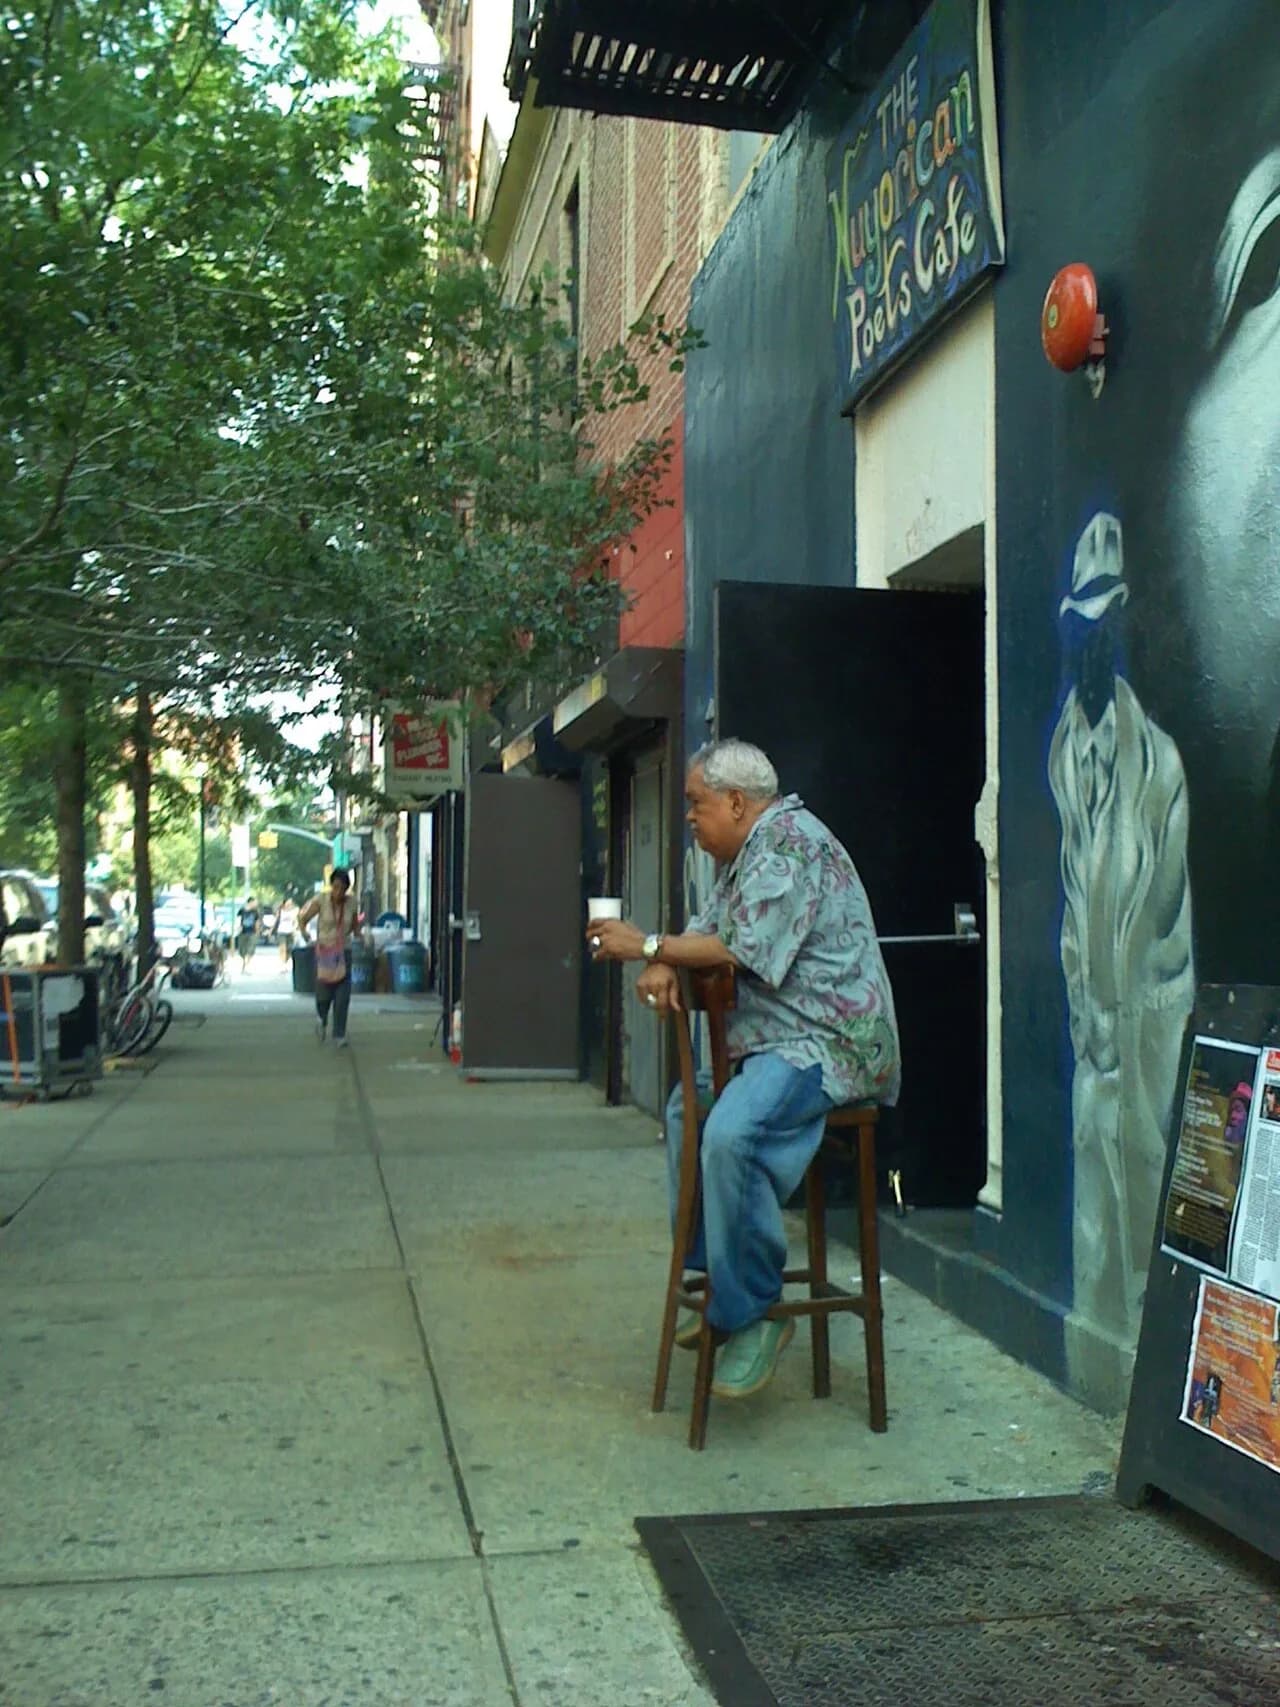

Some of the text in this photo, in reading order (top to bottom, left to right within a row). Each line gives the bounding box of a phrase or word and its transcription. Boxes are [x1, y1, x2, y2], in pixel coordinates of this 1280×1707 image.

[828, 70, 975, 321] Nuyorican
[876, 54, 921, 150] THE
[847, 174, 977, 384] Poets Cafe
